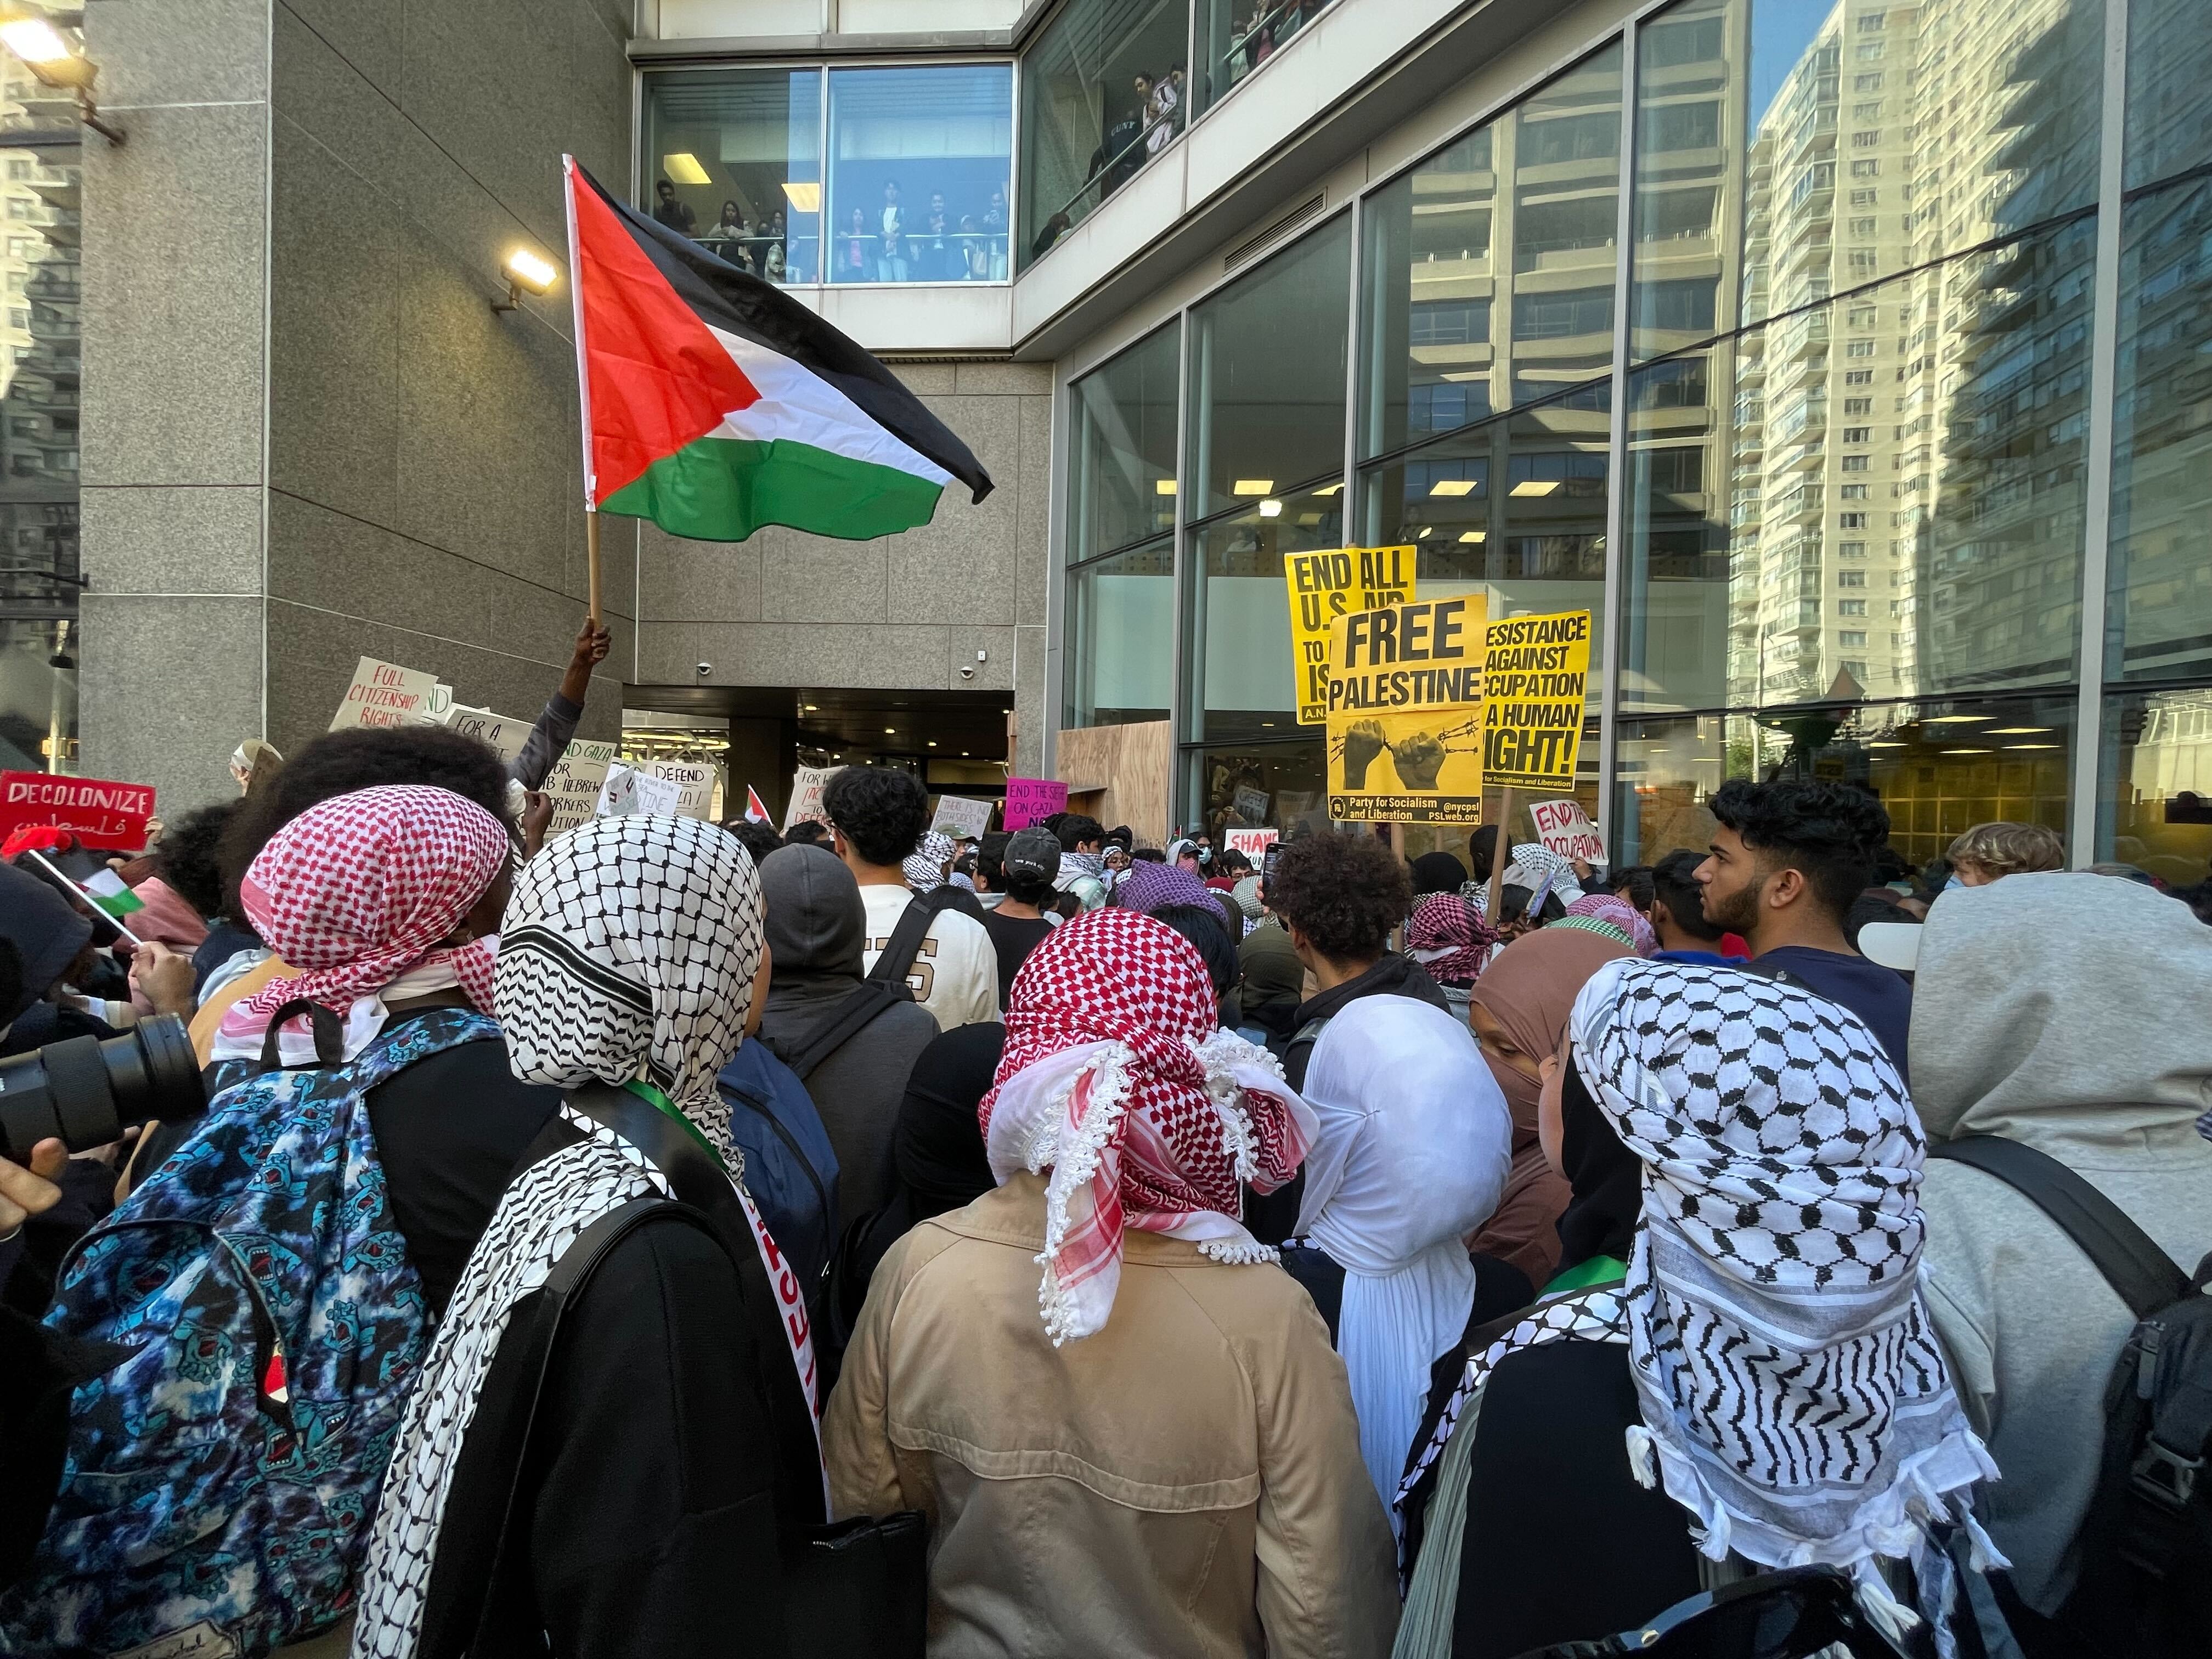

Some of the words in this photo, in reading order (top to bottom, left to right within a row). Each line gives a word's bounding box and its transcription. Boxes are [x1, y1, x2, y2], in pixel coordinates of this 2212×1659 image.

[1111, 121, 1136, 136] CUNY
[1294, 554, 1352, 592] END
[1361, 550, 1408, 590] ALL
[1345, 600, 1465, 669] FREE
[1486, 616, 1587, 647] ESISTANCE
[1303, 640, 1324, 663] TO
[1485, 646, 1569, 672] AGAINST
[373, 665, 404, 686] FULL
[349, 684, 419, 712] CITIZENSHIP
[1329, 667, 1482, 712] PALESTINE
[360, 707, 402, 726] RIGHTS
[1485, 704, 1498, 726] A
[1503, 704, 1580, 727] HUMAN
[456, 715, 486, 737] FOR
[490, 724, 501, 741] A
[584, 744, 612, 762] GAZA
[1483, 729, 1575, 774] IGHT!
[554, 763, 571, 778] OR
[656, 766, 704, 782] DEFEND
[802, 772, 821, 786] FOR
[1009, 785, 1030, 798] END
[1034, 785, 1048, 798] THE
[1493, 776, 1523, 785] Socialism
[1537, 779, 1571, 787] Liberation
[7, 783, 149, 814] DECOLONIZE
[550, 797, 591, 812] ORKERS
[1014, 802, 1028, 814] ON
[1031, 802, 1053, 815] GAZA
[1350, 797, 1373, 809] Party
[1376, 798, 1387, 807] for
[1389, 797, 1437, 809] Socialism
[1443, 802, 1479, 813] @nycpsl
[1350, 809, 1365, 819] and
[1368, 809, 1413, 820] Liberation
[1429, 812, 1479, 823] PSLweb.org
[1536, 803, 1572, 833] END
[1231, 832, 1278, 853] SHAME
[1543, 834, 1605, 860] OCCUPATION
